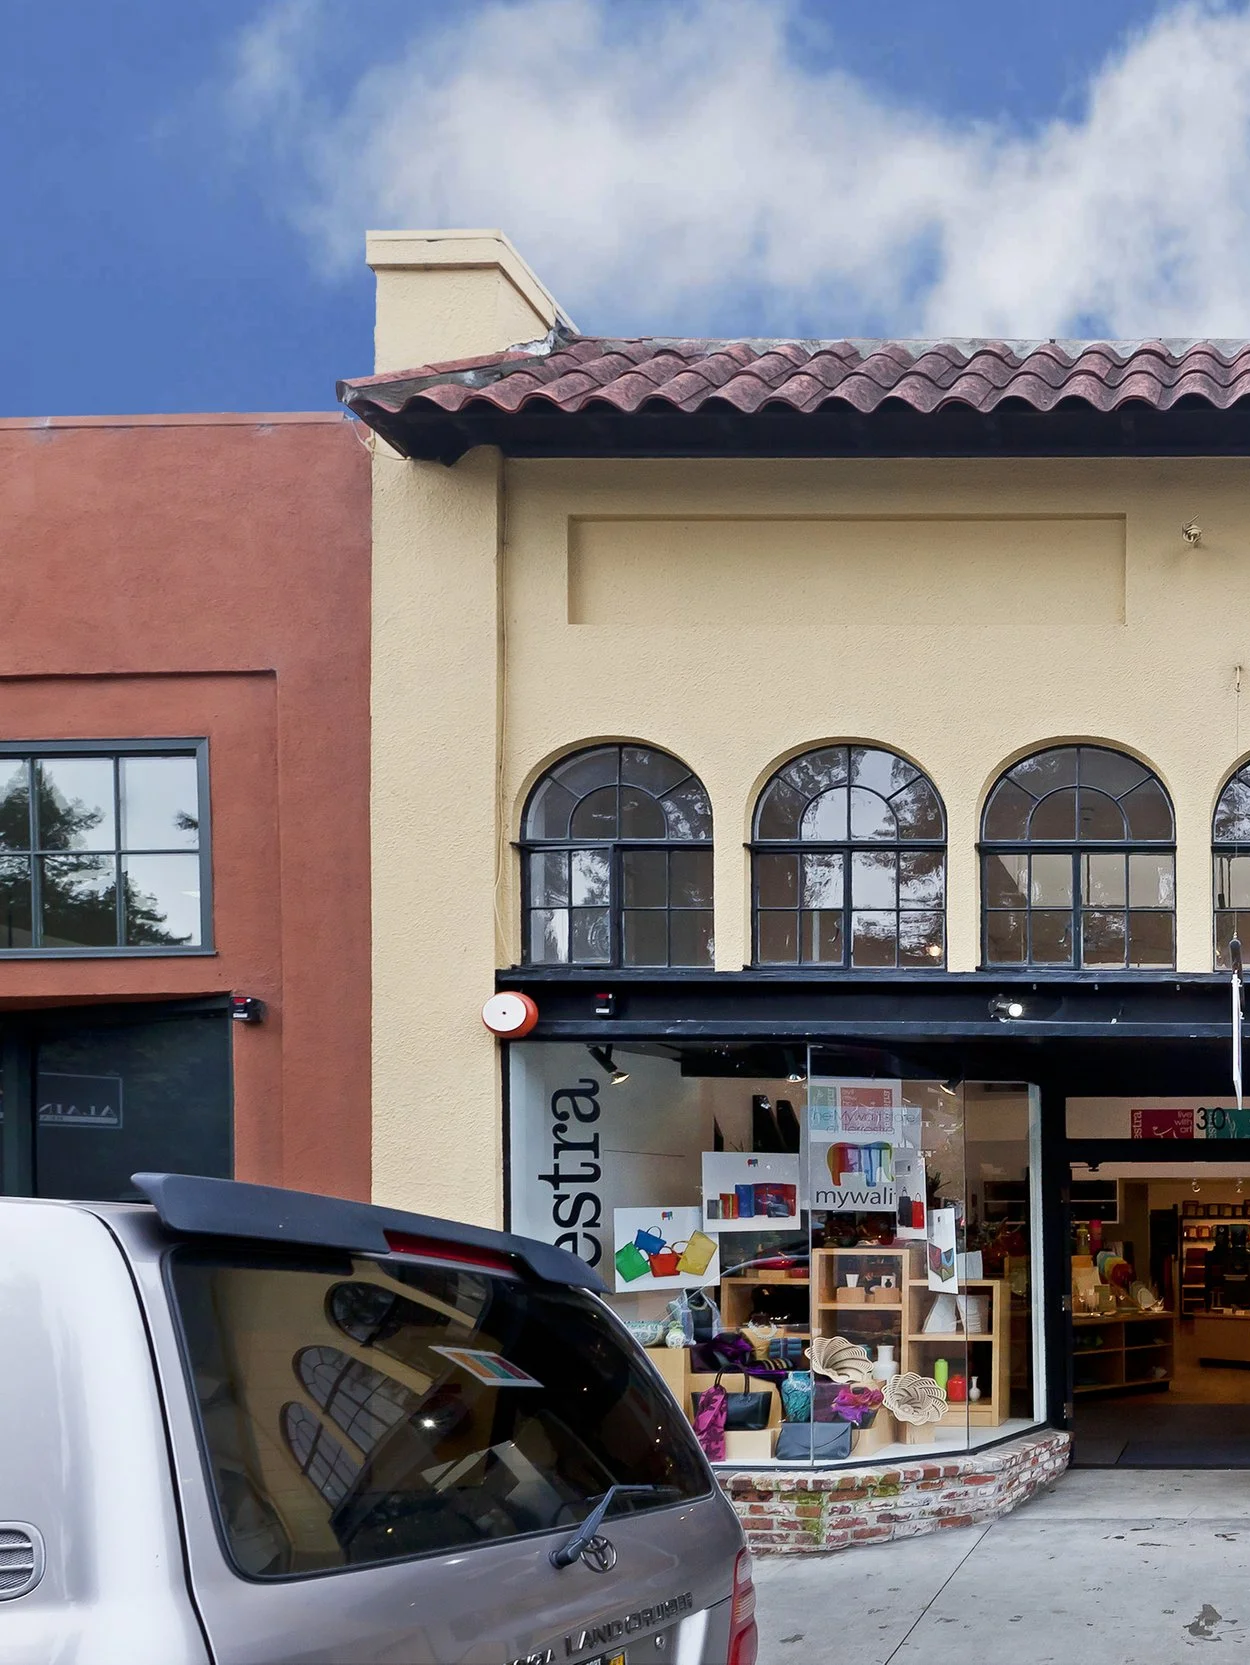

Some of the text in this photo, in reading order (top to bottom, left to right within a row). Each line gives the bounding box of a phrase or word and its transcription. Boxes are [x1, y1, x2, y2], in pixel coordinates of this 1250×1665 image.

[1196, 1107, 1226, 1130] 30
[537, 1078, 602, 1268] estra
[816, 1187, 896, 1208] mywali
[565, 1620, 624, 1657] LAND
